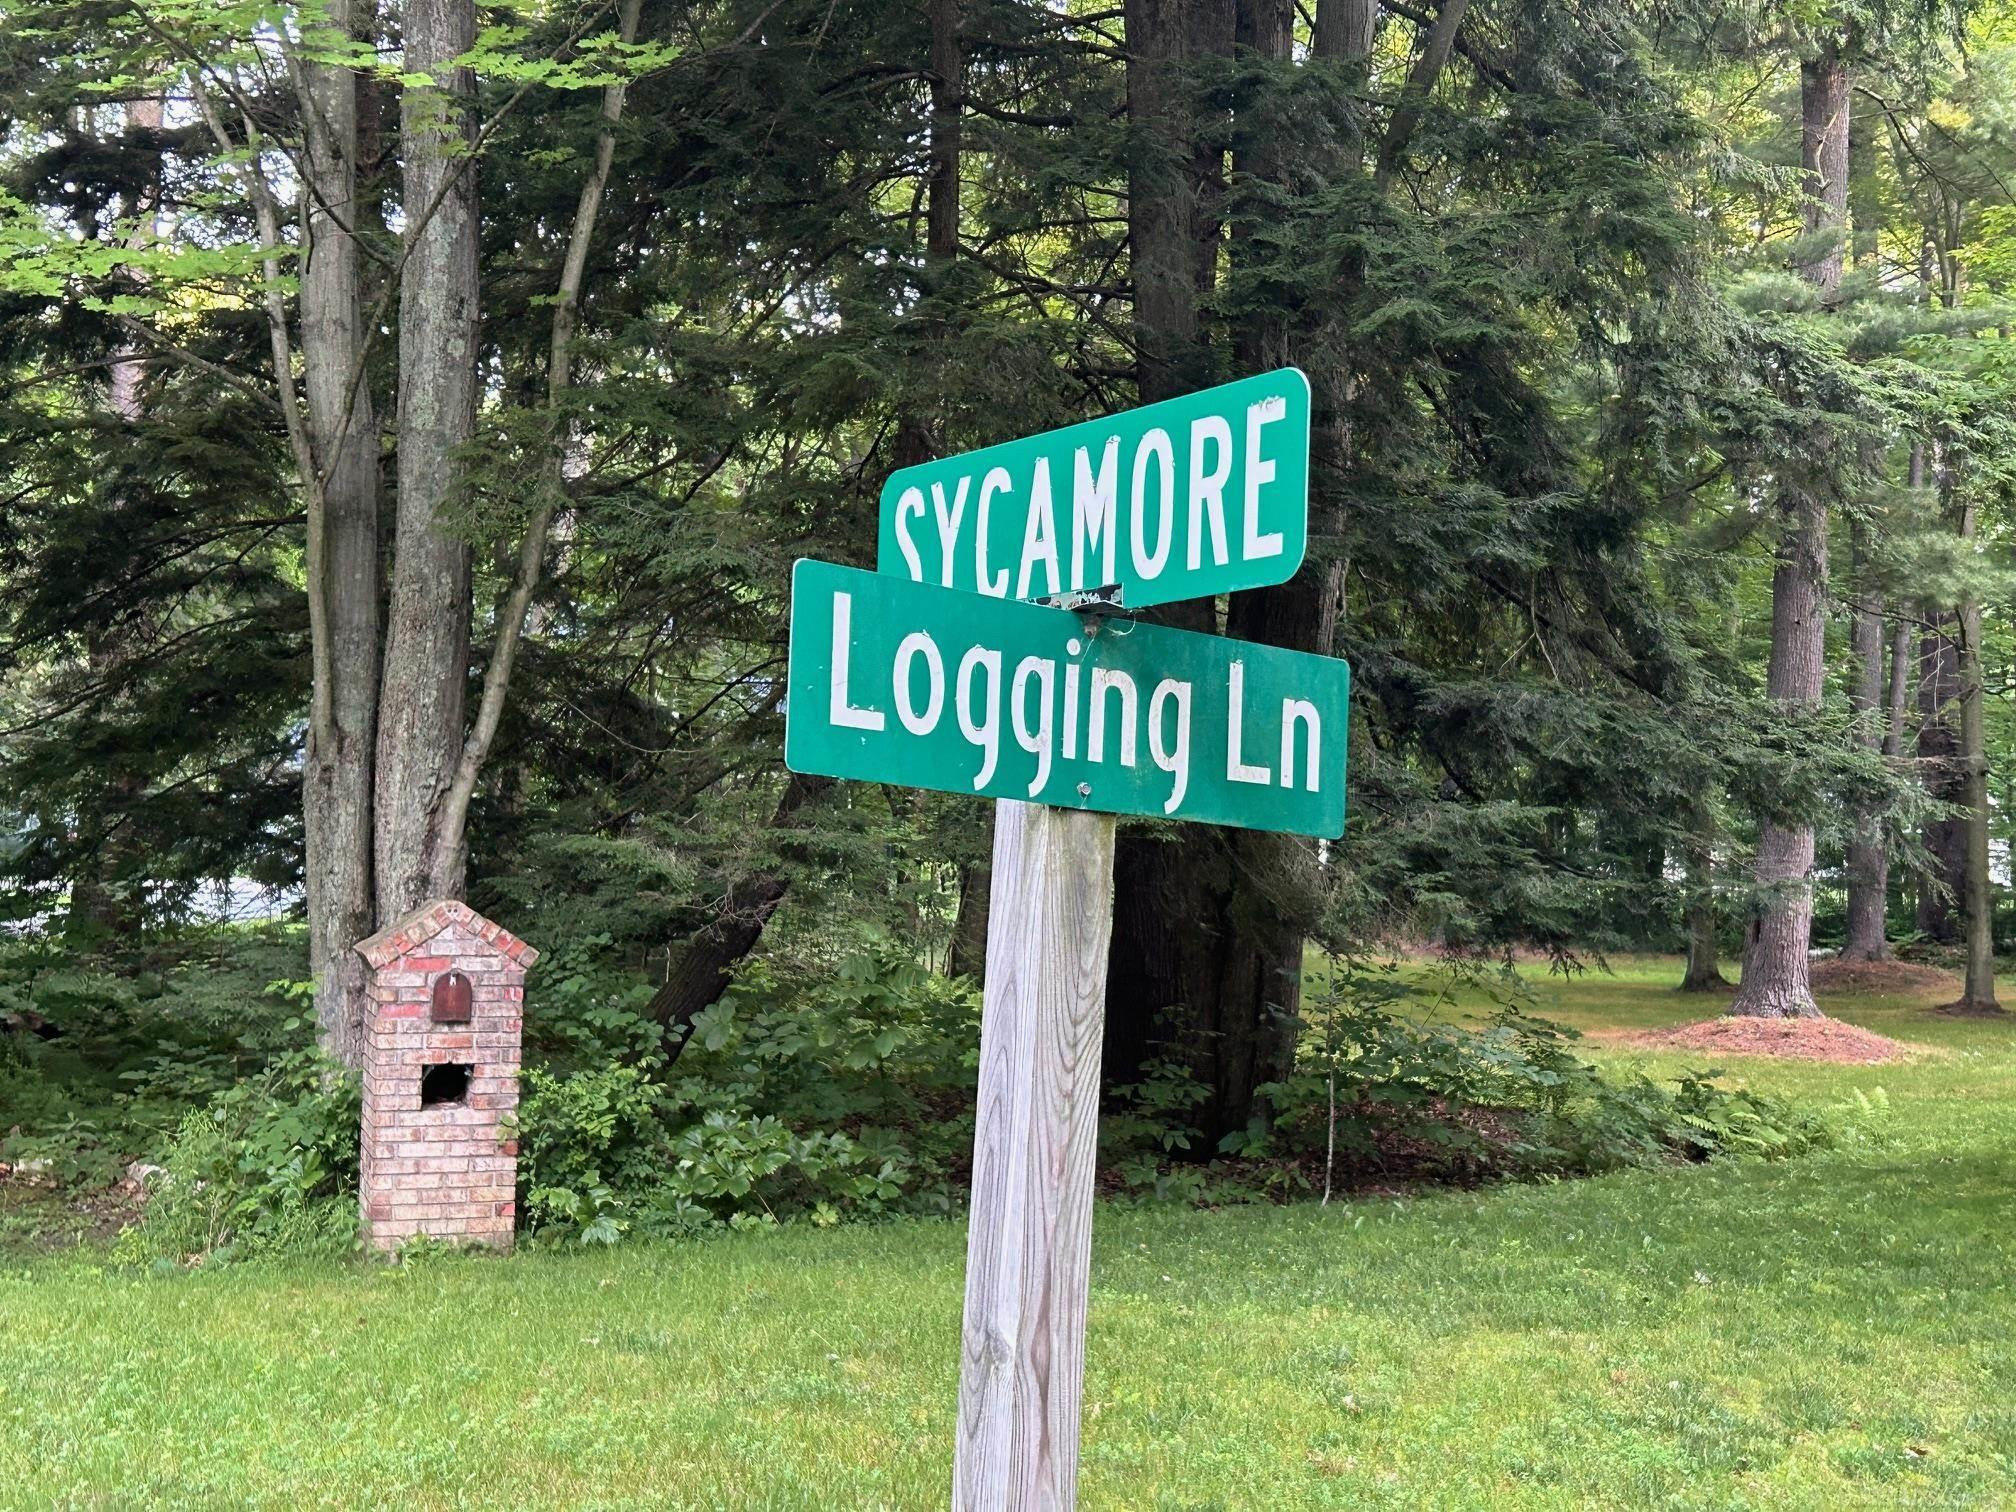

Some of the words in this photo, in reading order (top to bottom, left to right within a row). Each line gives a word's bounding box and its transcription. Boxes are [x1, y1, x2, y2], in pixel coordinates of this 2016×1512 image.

[895, 397, 1286, 600] SYCAMORE
[829, 591, 1192, 815] Logging
[1226, 659, 1321, 793] Ln
